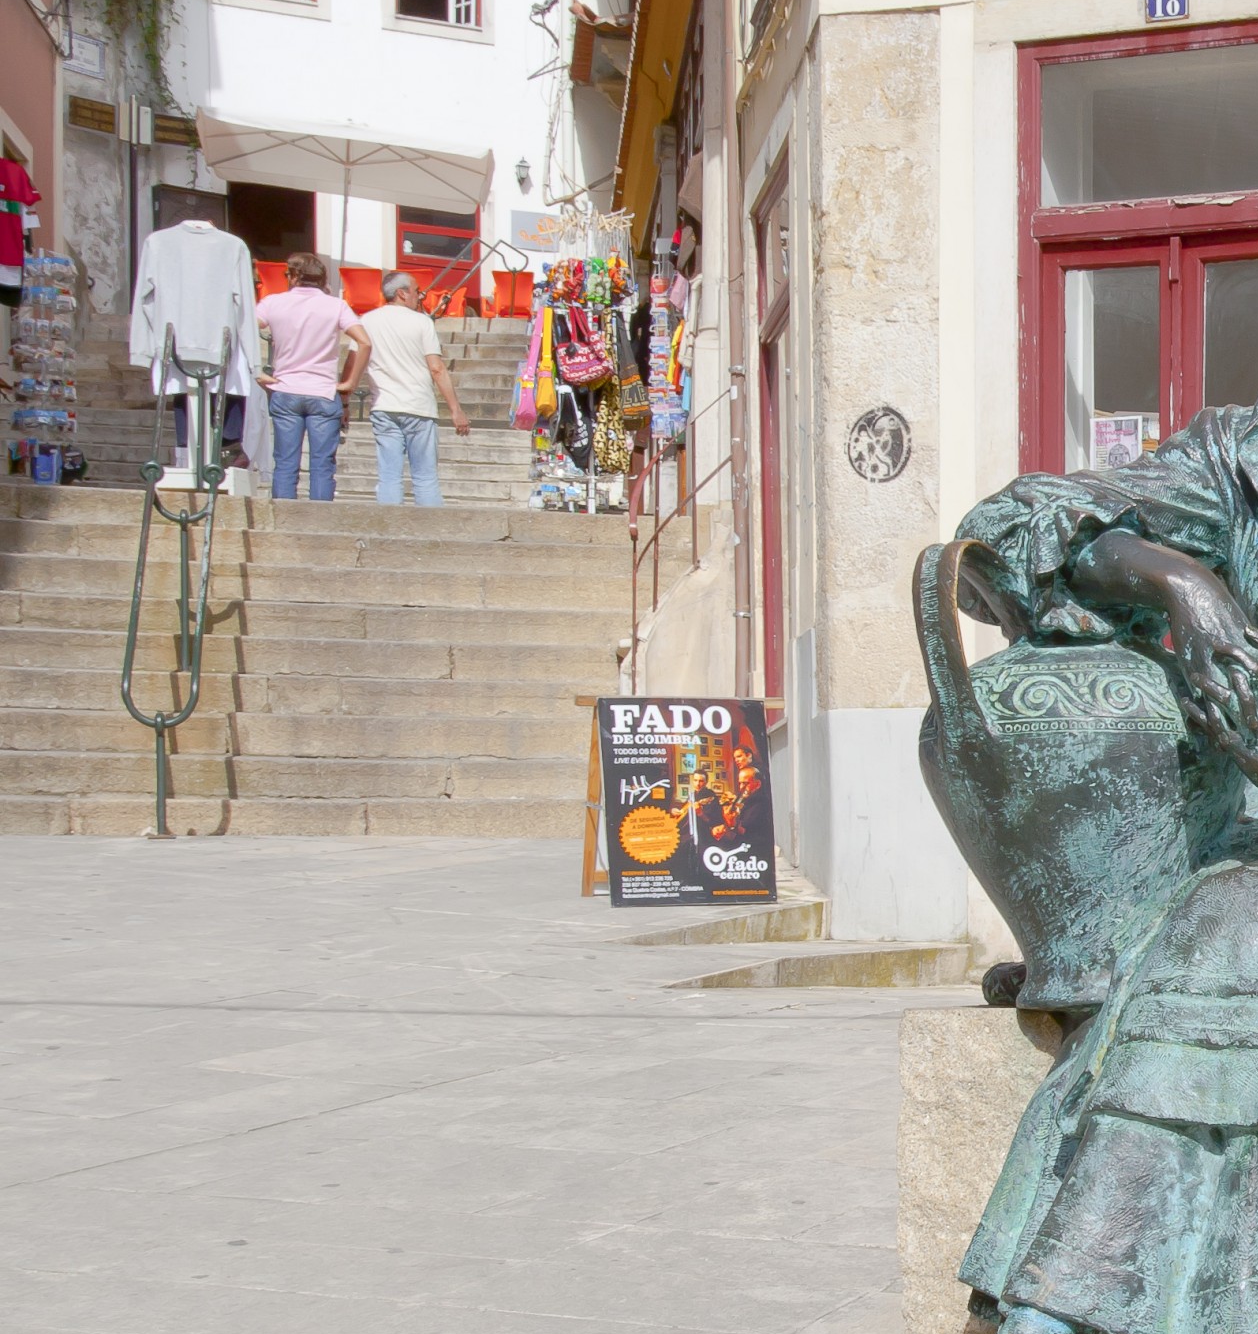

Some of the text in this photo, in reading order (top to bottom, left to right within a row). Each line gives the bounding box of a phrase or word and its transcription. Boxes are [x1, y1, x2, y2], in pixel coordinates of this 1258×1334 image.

[610, 704, 732, 735] FADO
[612, 734, 703, 745] DE COIMBRA
[727, 856, 768, 872] fado
[719, 870, 760, 880] centro
